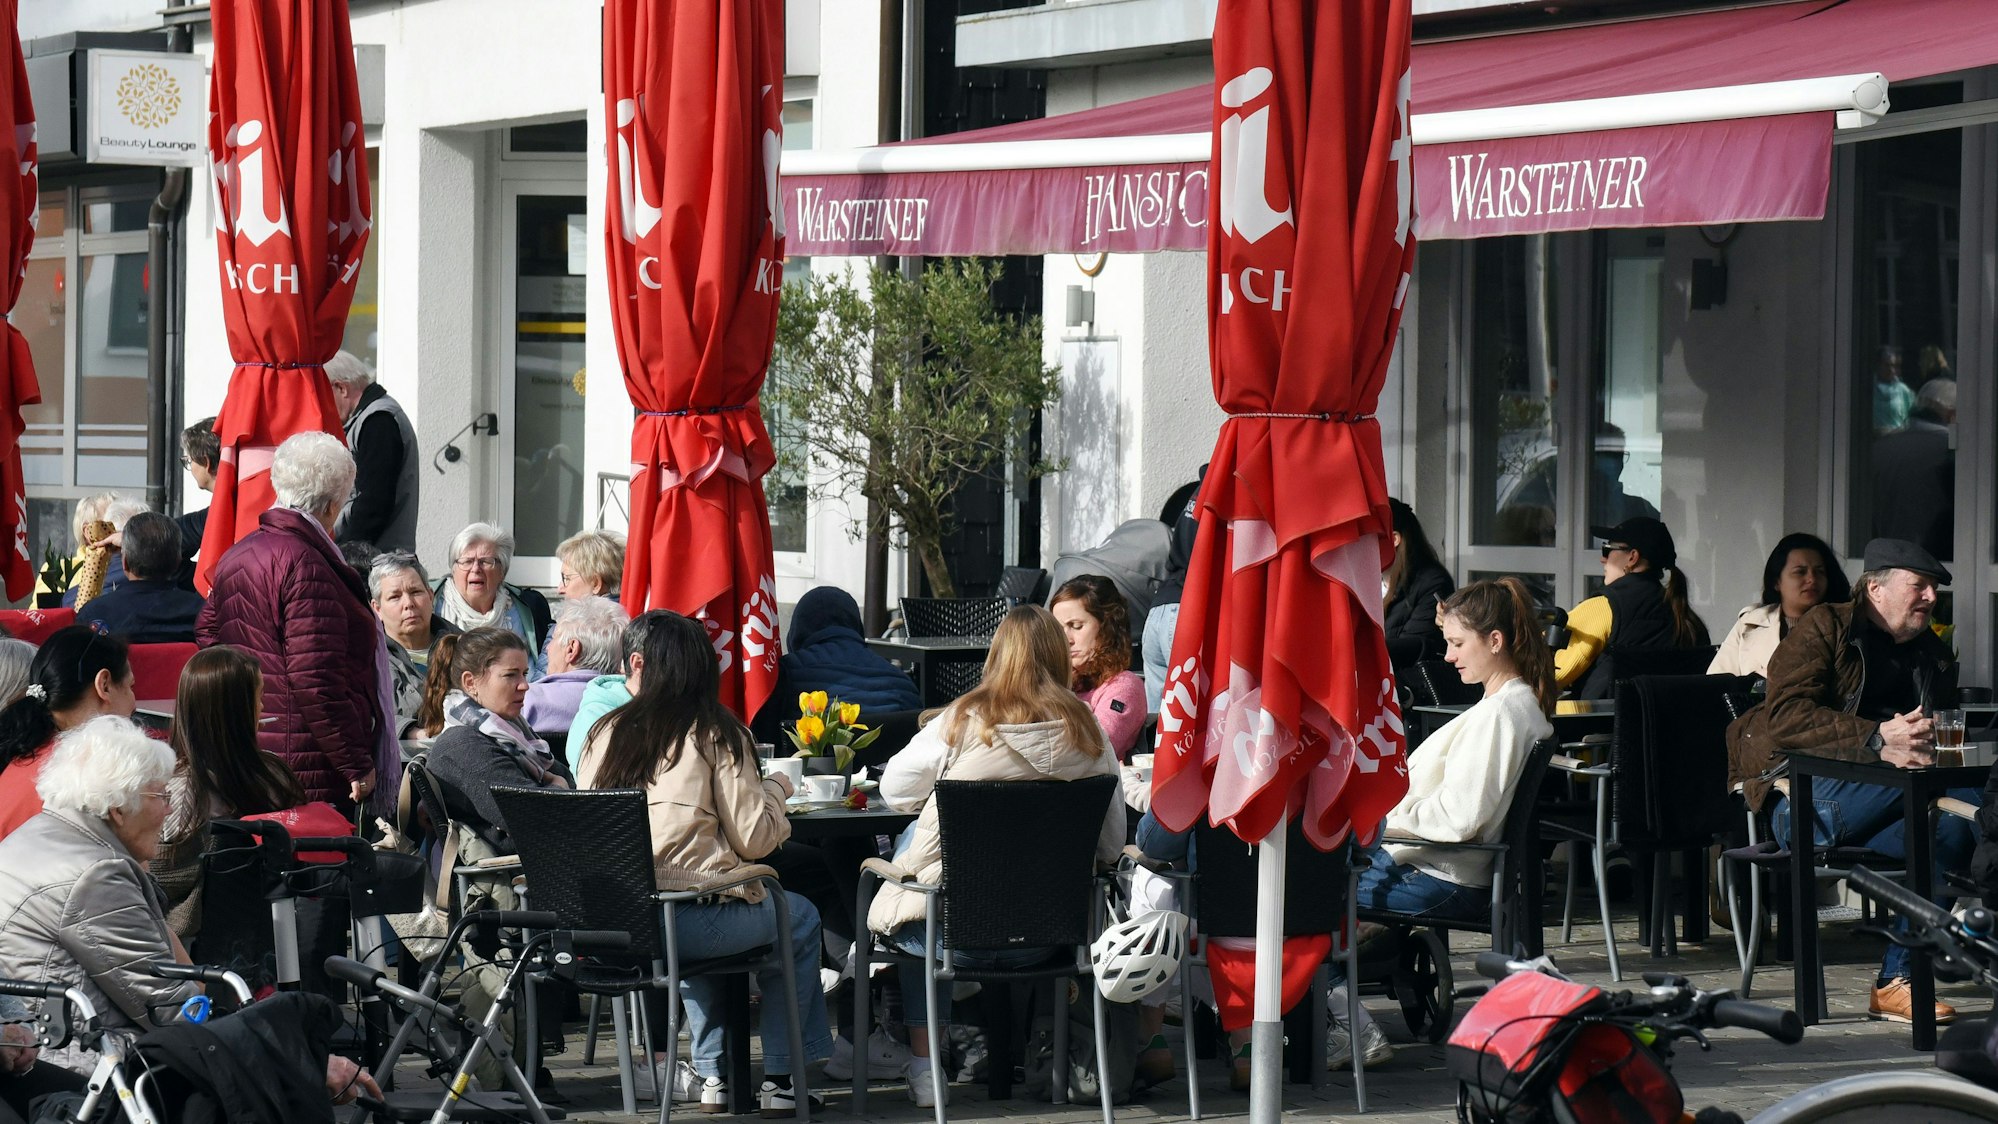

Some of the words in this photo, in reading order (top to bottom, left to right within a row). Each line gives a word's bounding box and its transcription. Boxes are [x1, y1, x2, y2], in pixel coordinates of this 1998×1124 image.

[100, 136, 147, 149] Beauty
[148, 138, 197, 151] Lounge
[1448, 152, 1648, 222] WARSTEINER
